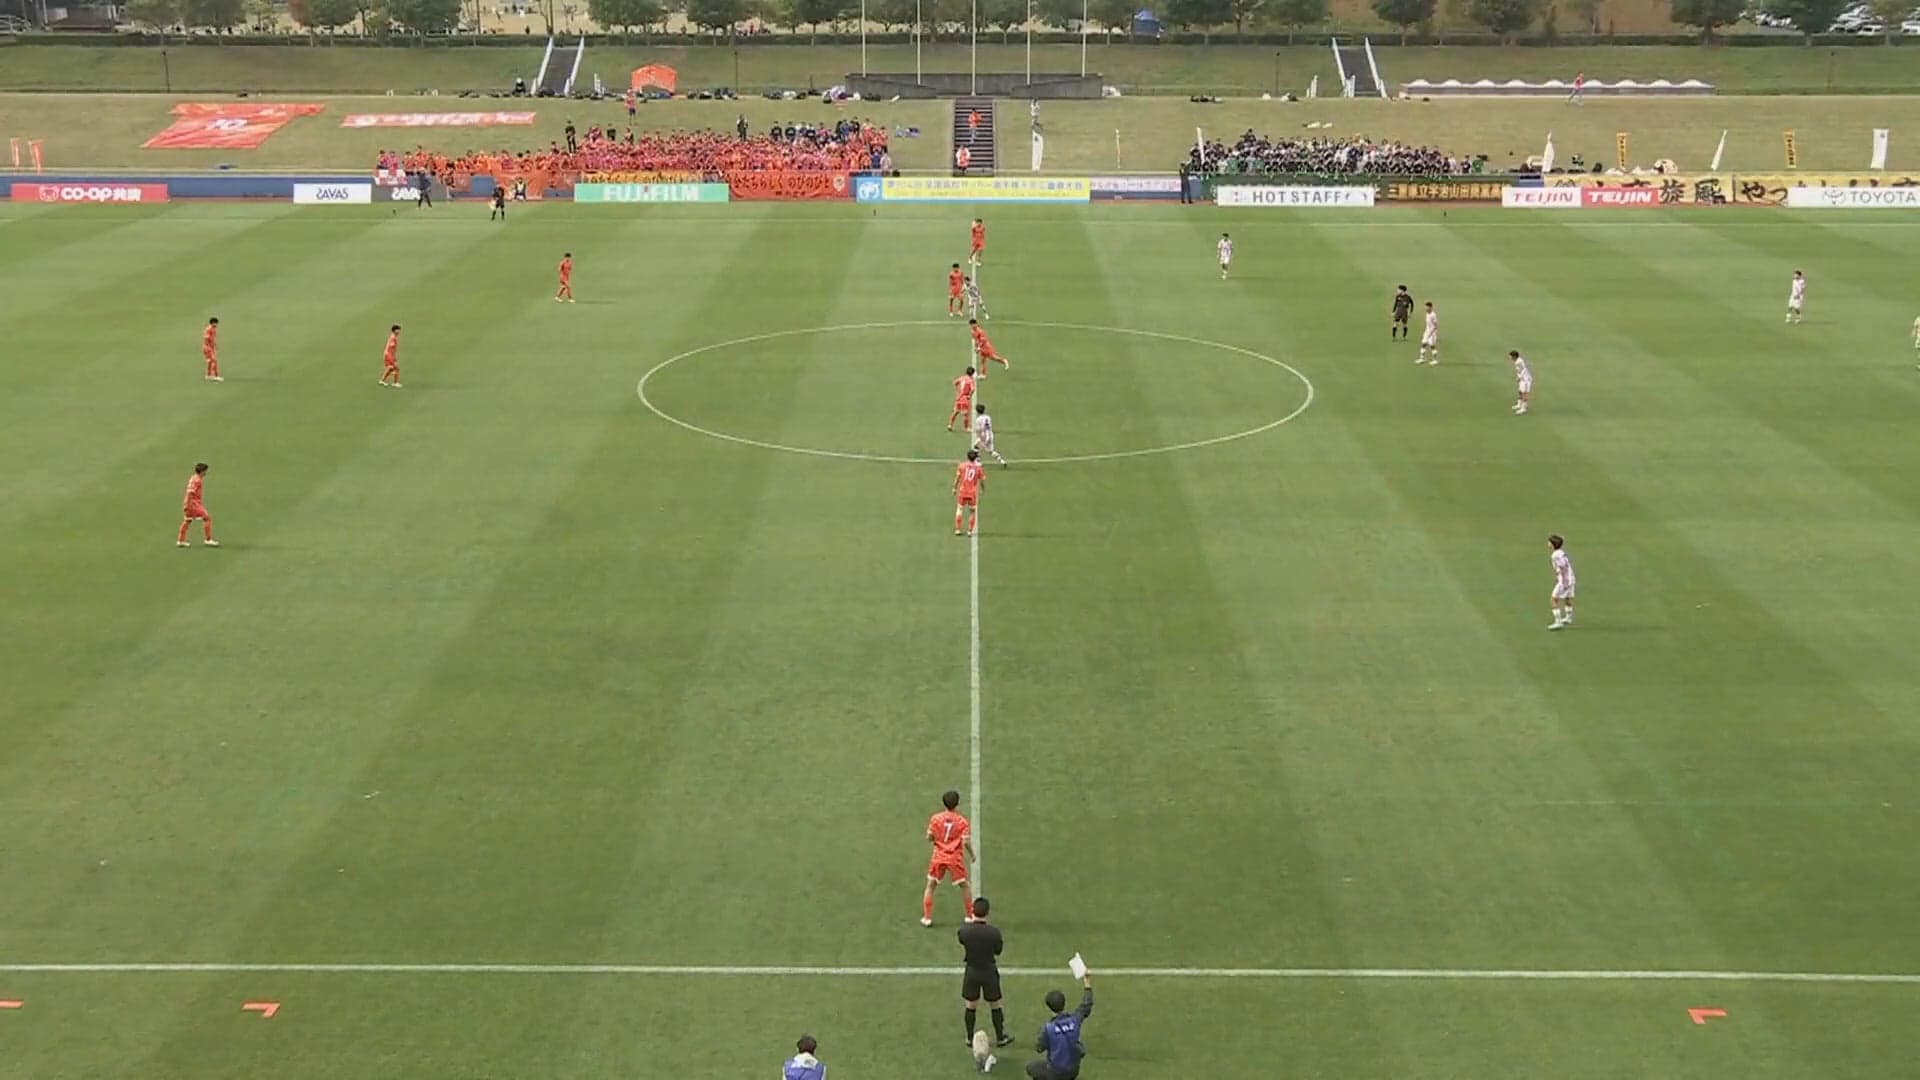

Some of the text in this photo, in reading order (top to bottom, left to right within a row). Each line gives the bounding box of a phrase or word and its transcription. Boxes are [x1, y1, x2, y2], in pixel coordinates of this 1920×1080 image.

[316, 187, 349, 200] SAVAS
[391, 186, 421, 201] SAVA
[603, 185, 699, 201] FUJIFILM
[1513, 192, 1573, 205] TEIJIN
[1588, 191, 1653, 204] TEIJIN
[1850, 191, 1916, 204] TOYOTA
[965, 466, 977, 481] 10
[943, 822, 953, 843] 7
